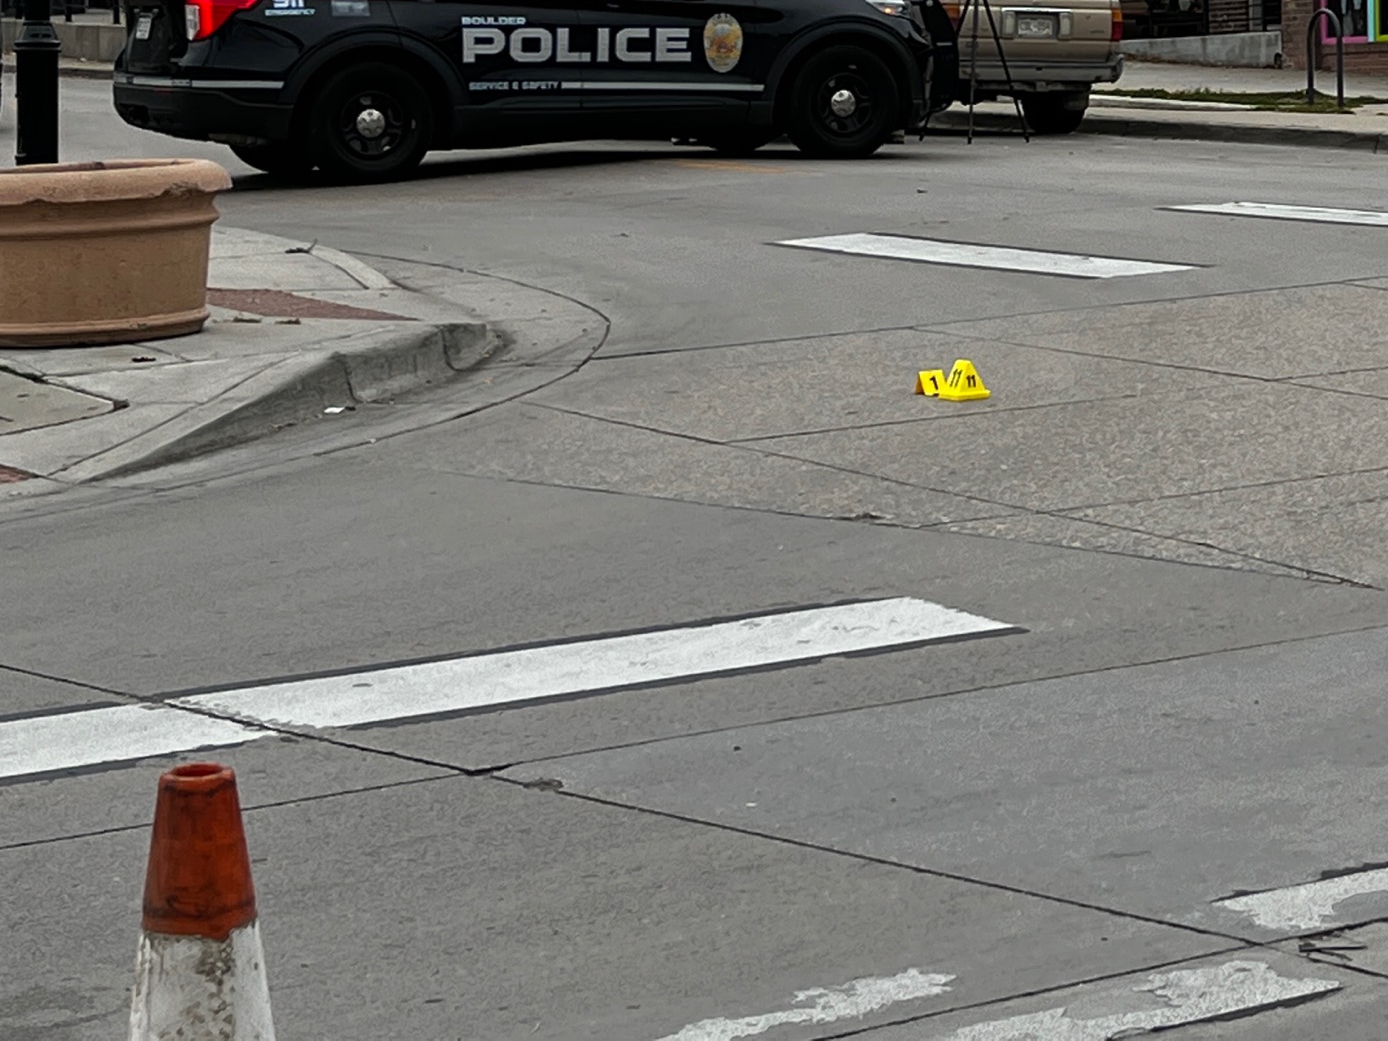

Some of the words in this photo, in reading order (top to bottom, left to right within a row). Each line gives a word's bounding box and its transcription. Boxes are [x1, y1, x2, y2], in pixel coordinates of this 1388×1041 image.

[461, 16, 527, 25] BOULDER
[462, 27, 692, 63] POLICE
[469, 81, 510, 90] SERVICE
[522, 81, 559, 89] SAFETY
[929, 375, 939, 391] 1
[950, 368, 963, 389] 11
[966, 374, 977, 388] 11
